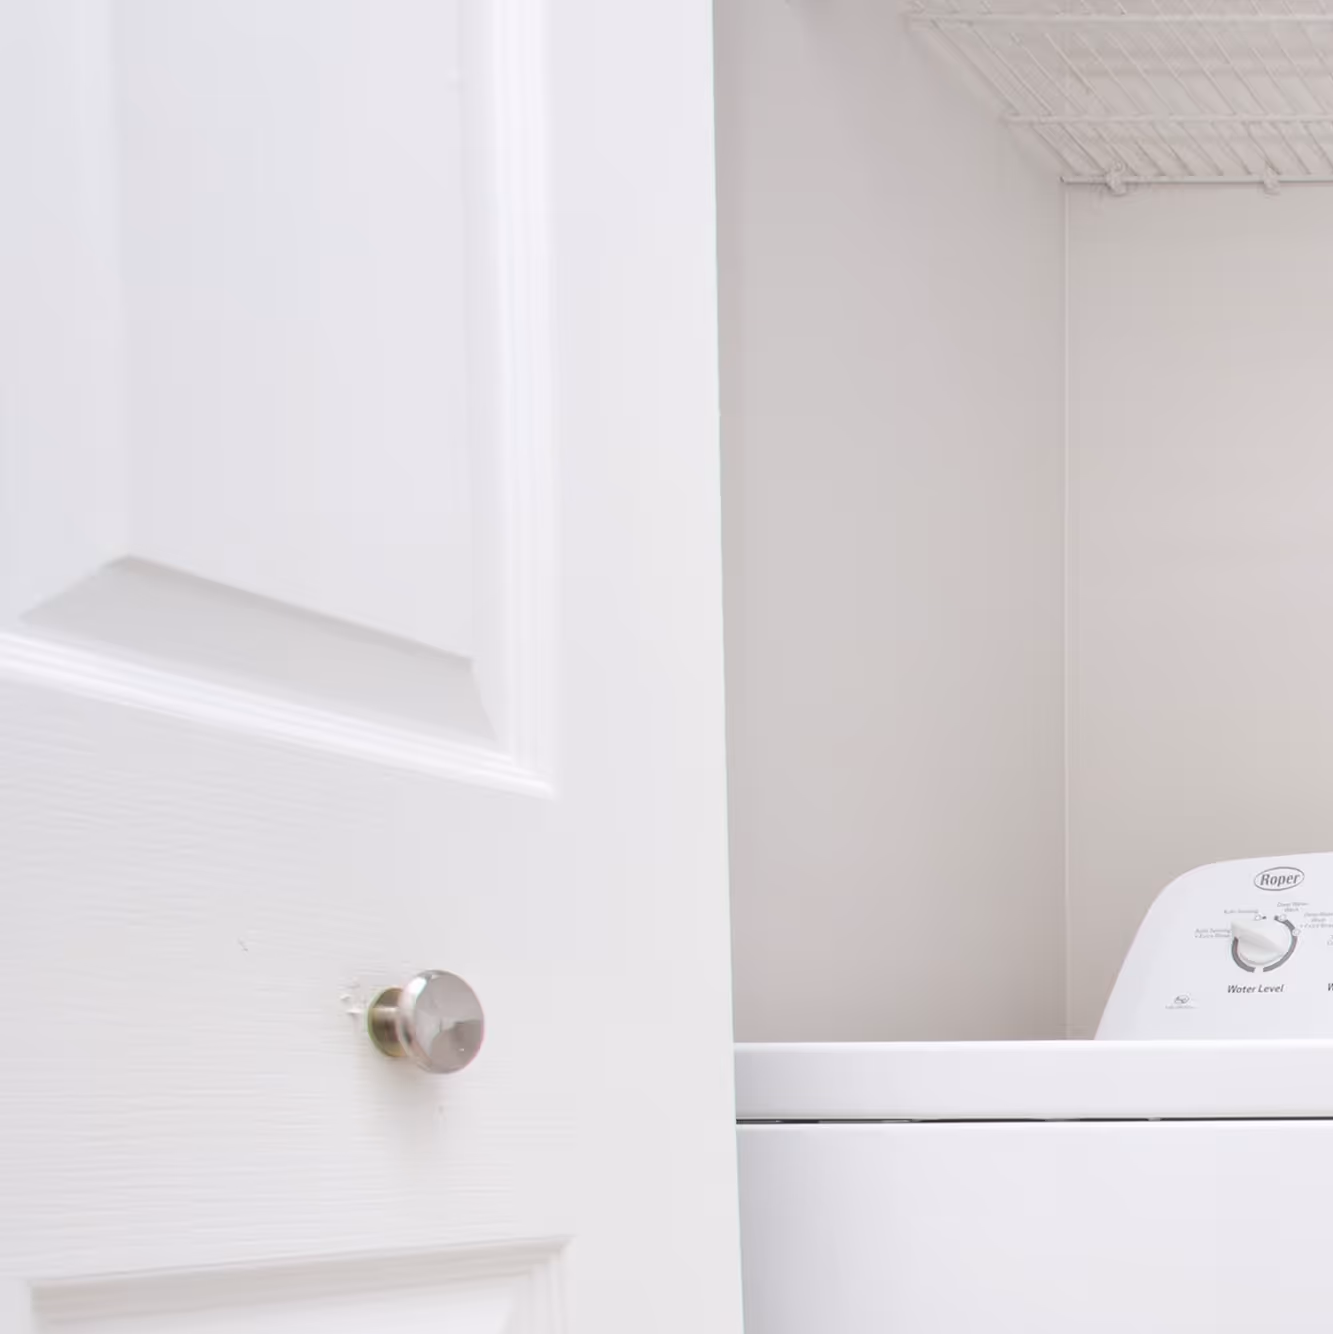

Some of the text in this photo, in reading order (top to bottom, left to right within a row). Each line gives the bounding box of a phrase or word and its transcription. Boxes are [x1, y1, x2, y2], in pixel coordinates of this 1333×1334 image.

[1259, 871, 1301, 888] Roper
[1227, 983, 1284, 994] Water Level
